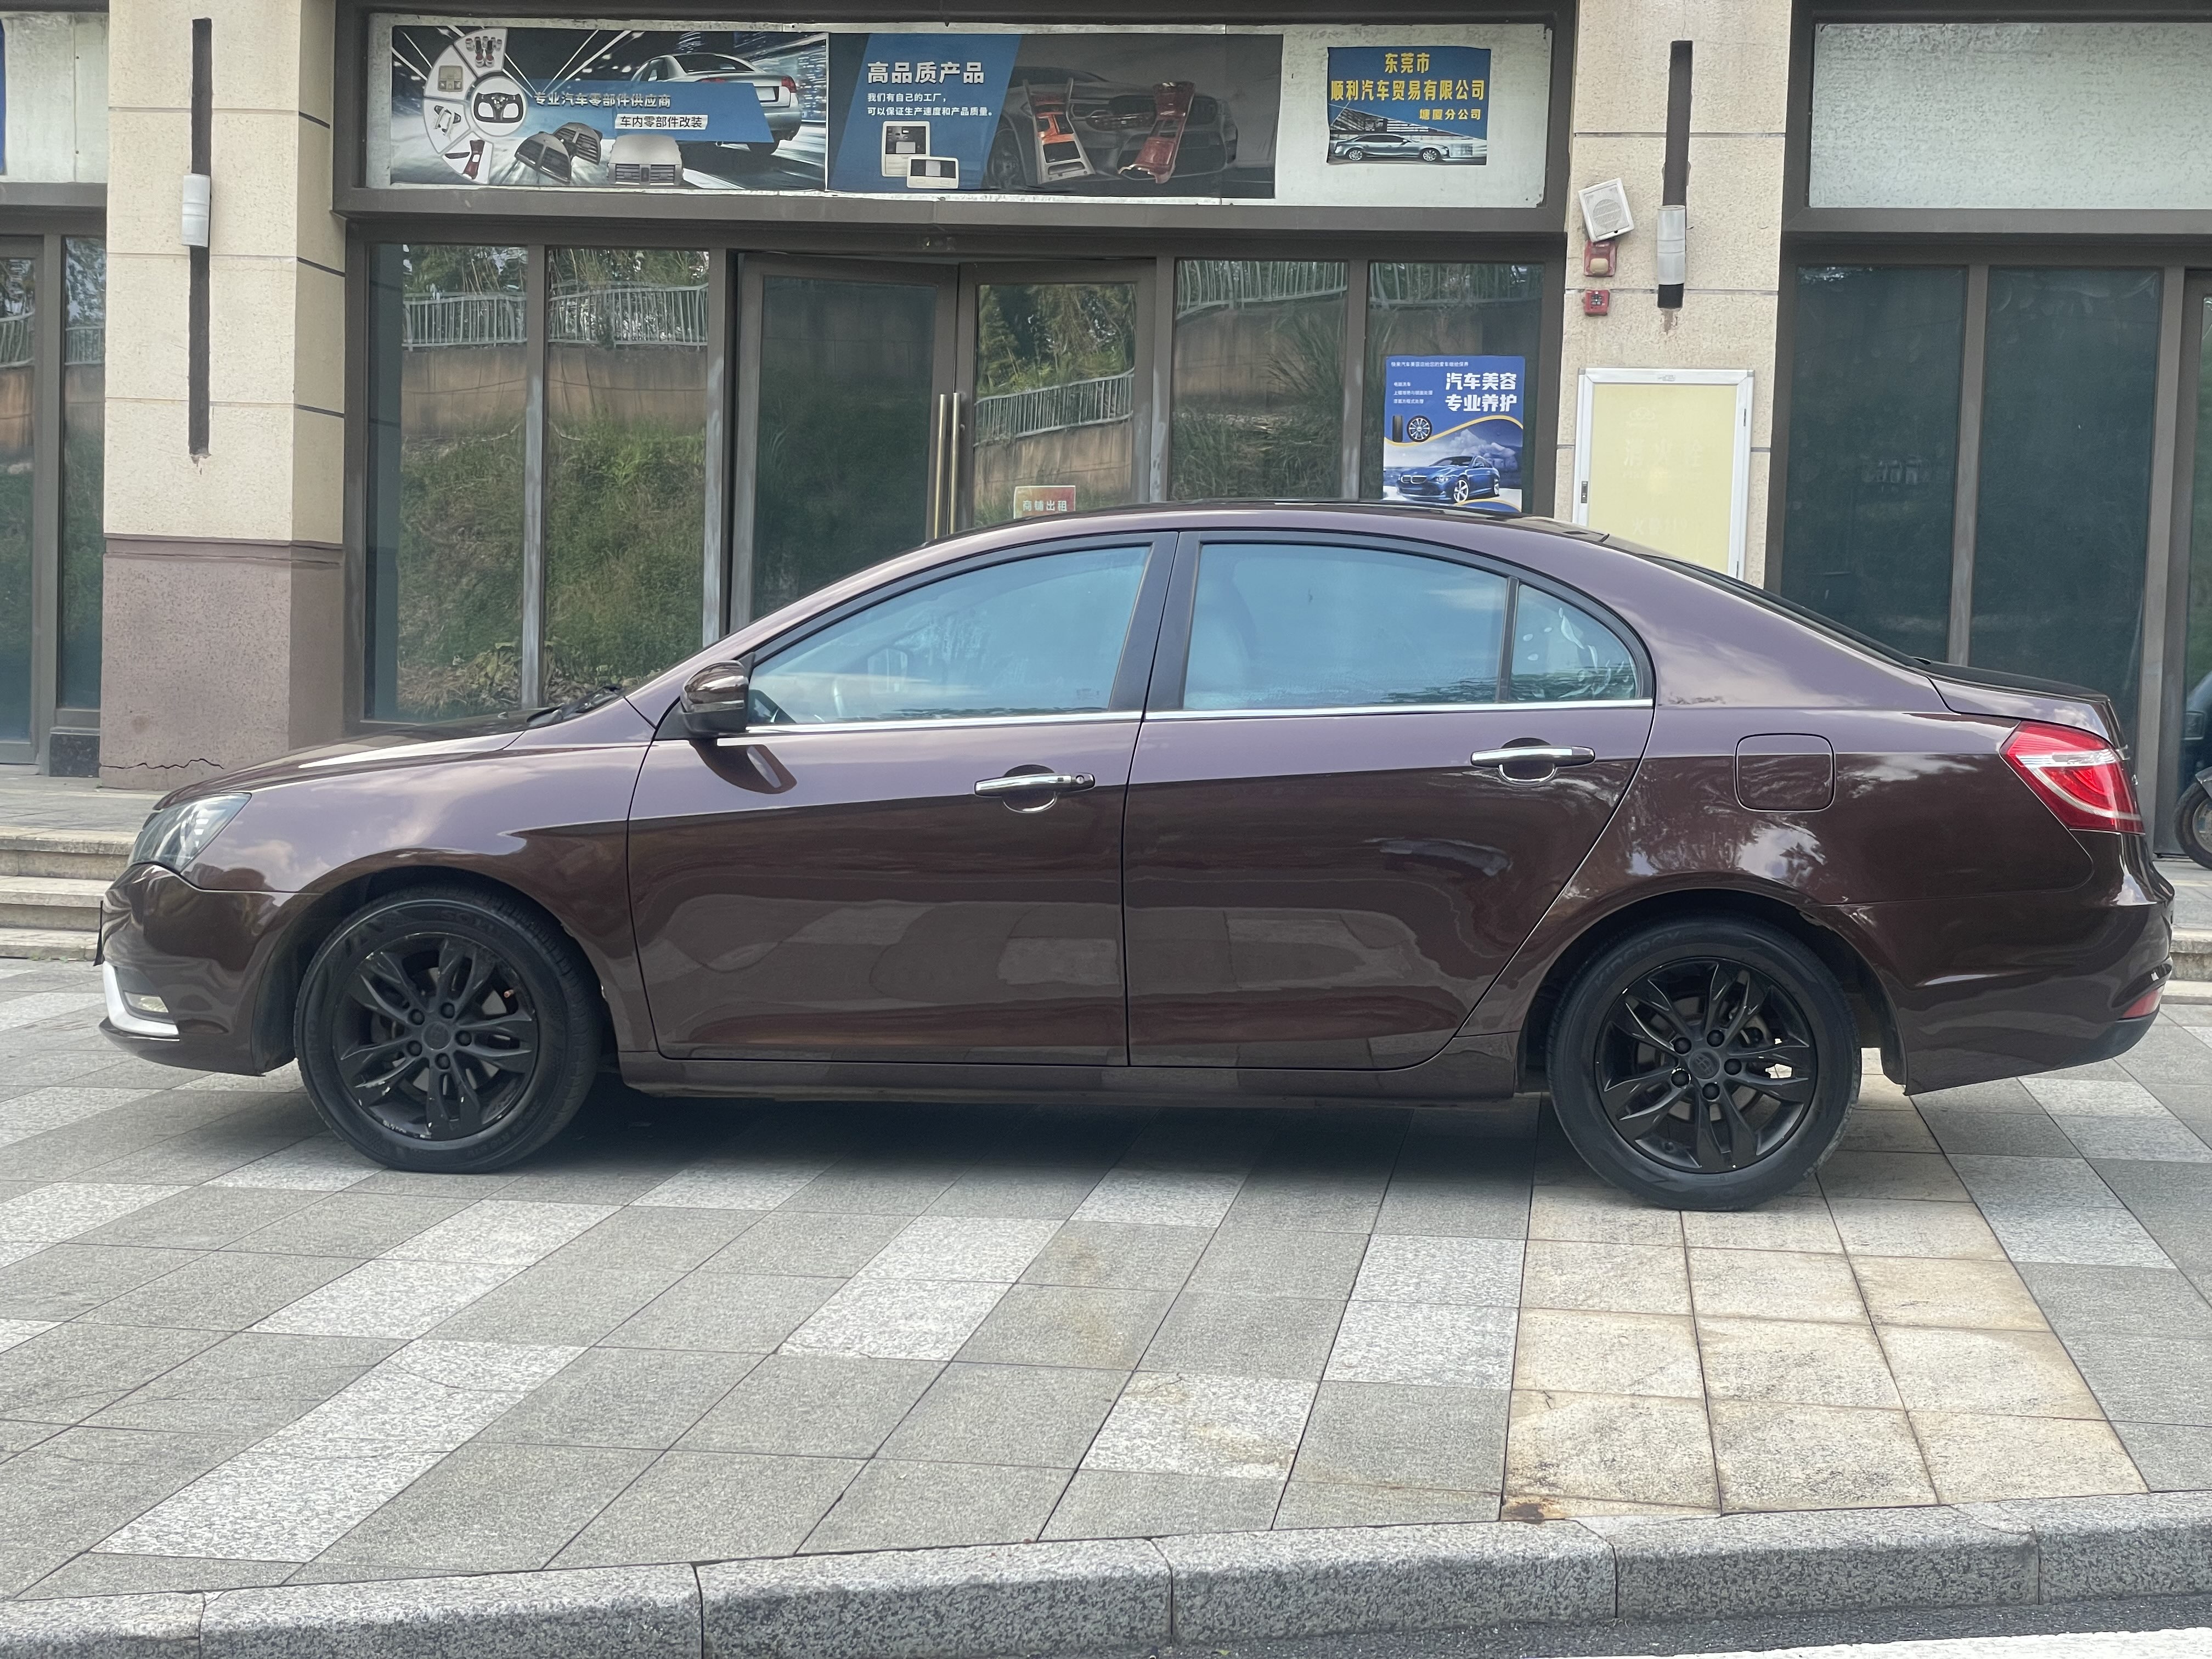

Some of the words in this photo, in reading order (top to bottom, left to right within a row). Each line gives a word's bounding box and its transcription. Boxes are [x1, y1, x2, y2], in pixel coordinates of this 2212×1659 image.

[867, 61, 984, 84] 高品质产品
[1385, 53, 1430, 74] 东莞市
[1330, 80, 1485, 101] 顺利汽车贸易有限公司
[534, 92, 672, 108] 专业汽车零部件供应商
[867, 107, 992, 116] 可以保证生产速度和产品质量。
[620, 116, 703, 128] 车内零部件改装
[1445, 373, 1517, 391] 汽车美容
[1445, 394, 1517, 412] 专业养护
[1023, 500, 1068, 512] 商铺出租
